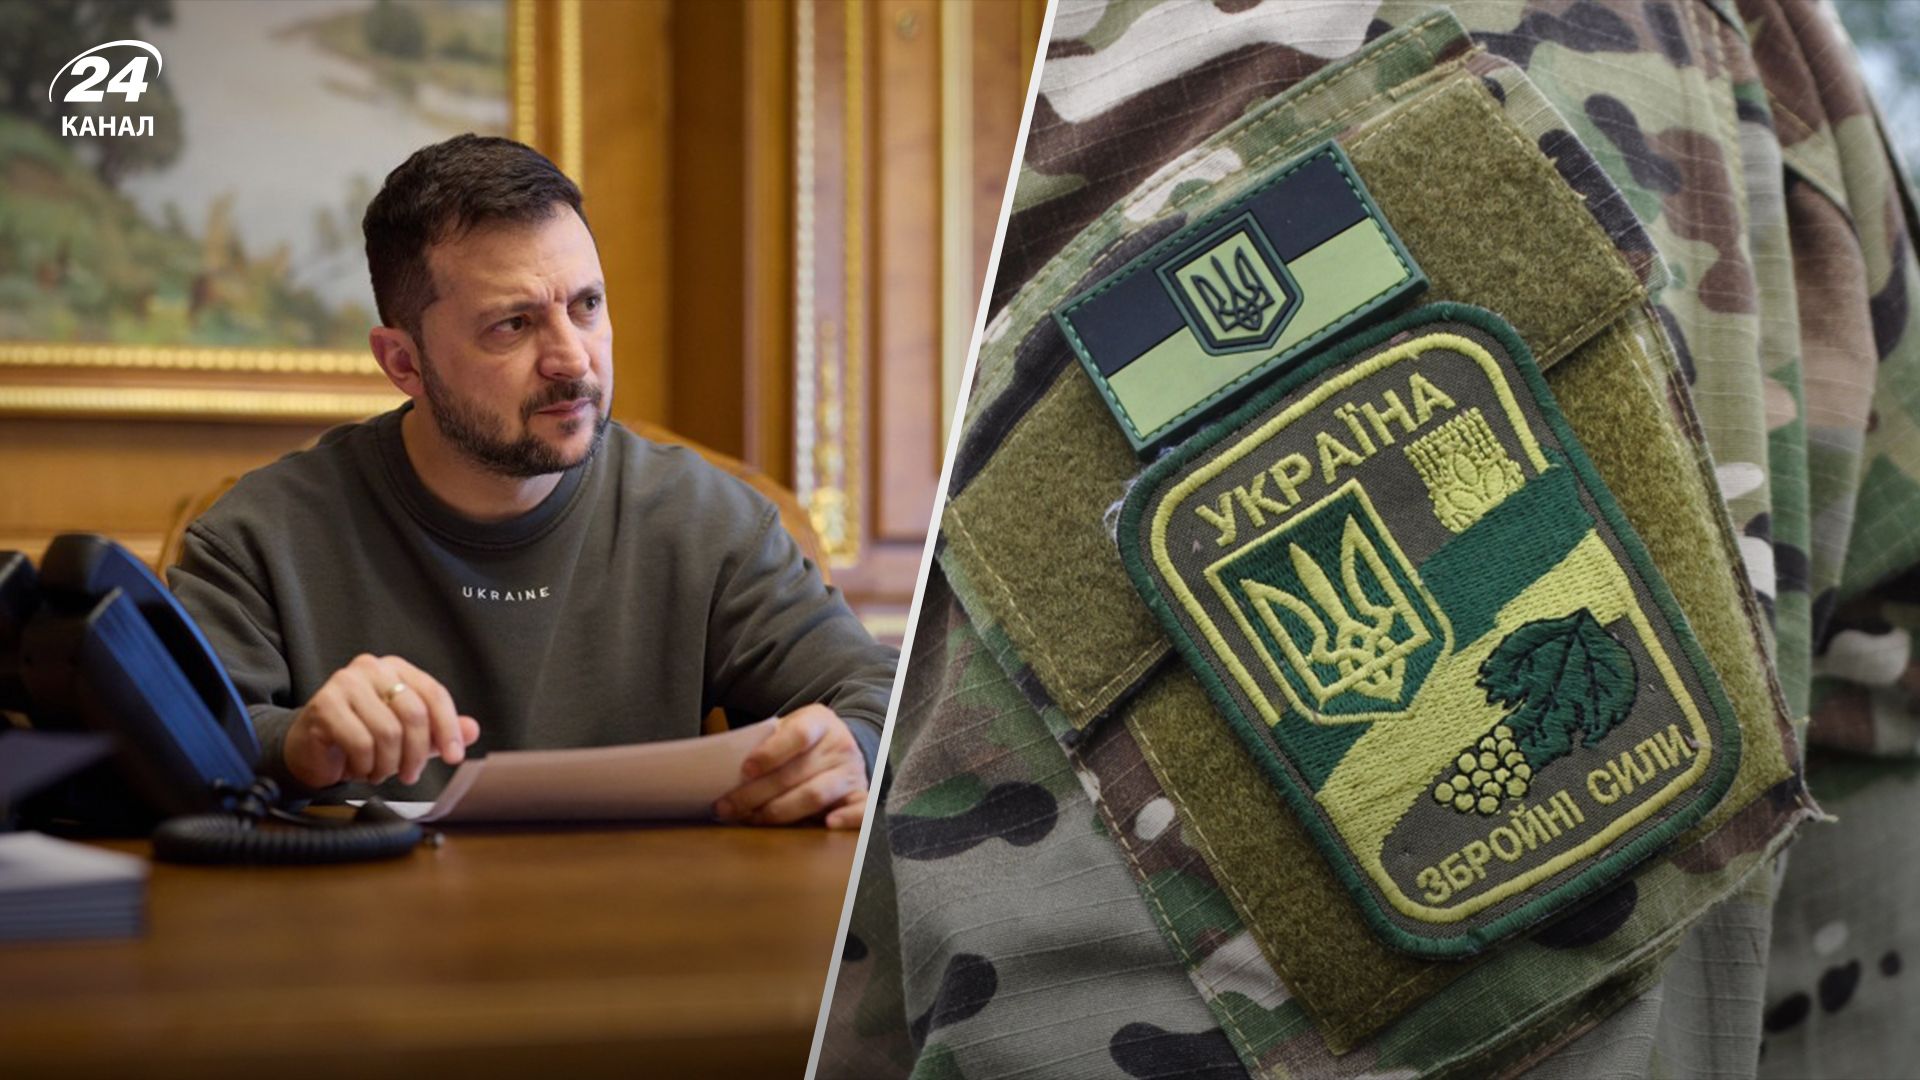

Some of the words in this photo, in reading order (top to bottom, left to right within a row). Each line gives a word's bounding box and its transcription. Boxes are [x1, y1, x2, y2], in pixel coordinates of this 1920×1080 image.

[1194, 372, 1456, 547] УКРАЇНА
[462, 586, 551, 602] UKRAINE
[1415, 789, 1586, 905] ЗБРОЙНІ
[1586, 723, 1697, 805] СИЛИ
